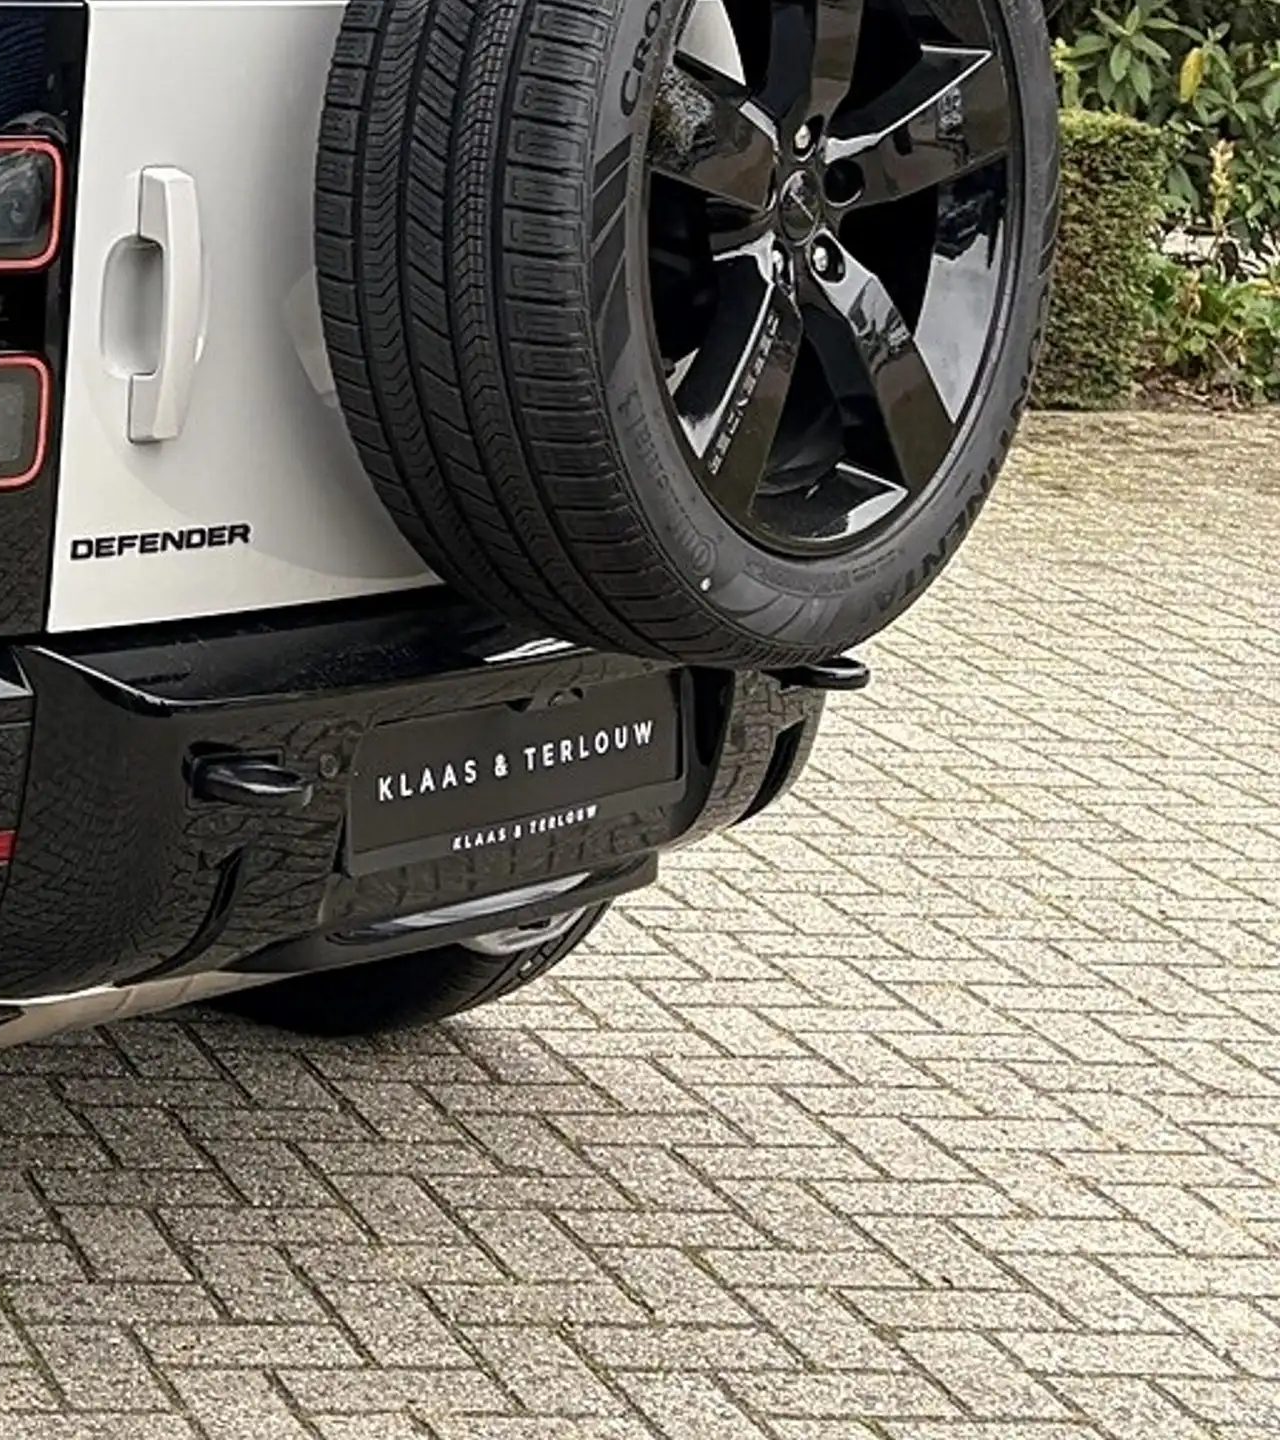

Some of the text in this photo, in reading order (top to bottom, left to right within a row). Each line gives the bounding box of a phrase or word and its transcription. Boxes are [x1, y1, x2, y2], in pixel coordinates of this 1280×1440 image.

[69, 522, 252, 561] DEFENDER
[376, 719, 656, 802] KLAAS & TERLOUW
[452, 825, 507, 851] KLAAS
[528, 804, 600, 835] TERLOUW
